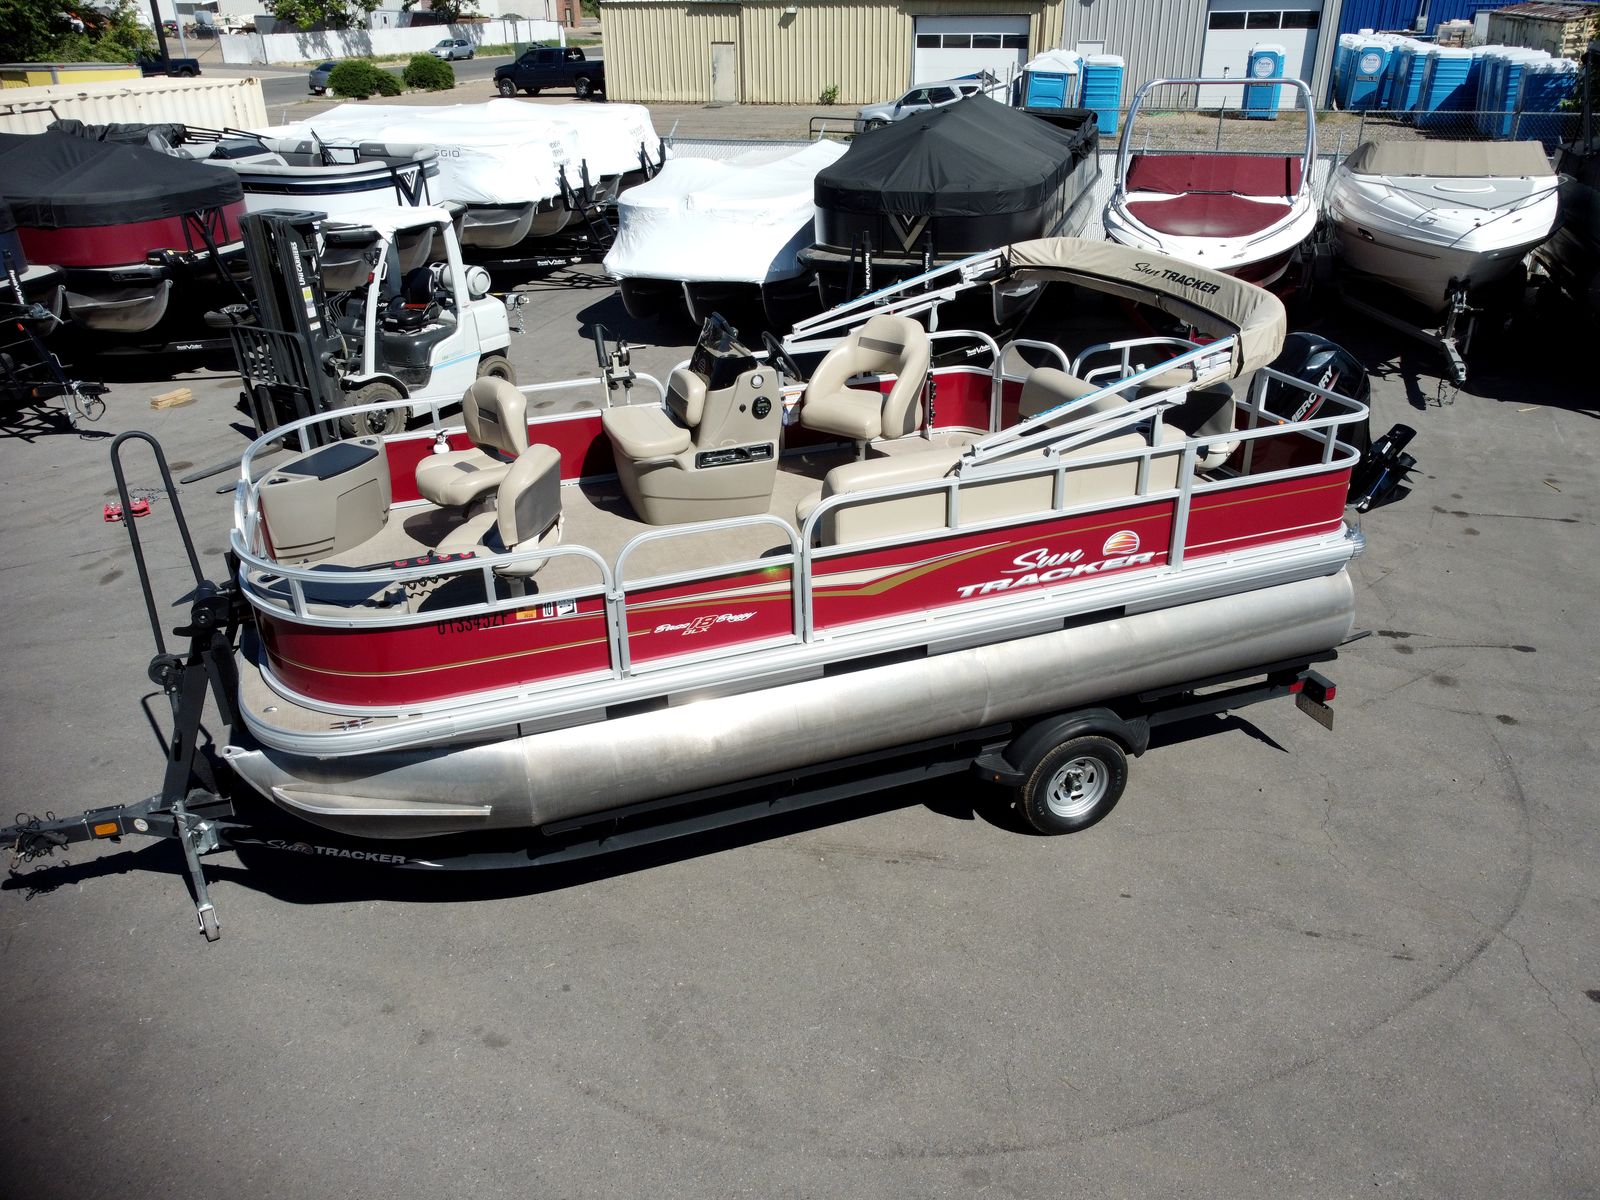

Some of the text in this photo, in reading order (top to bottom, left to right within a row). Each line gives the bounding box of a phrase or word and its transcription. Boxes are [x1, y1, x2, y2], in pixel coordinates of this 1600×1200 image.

[290, 241, 306, 286] UNICARRIERS
[1128, 262, 1220, 294] Sun TRACKER
[1291, 364, 1333, 422] MERCRY
[957, 551, 1155, 598] TRACKER
[1000, 547, 1085, 574] Sun
[314, 845, 406, 864] TRACKER
